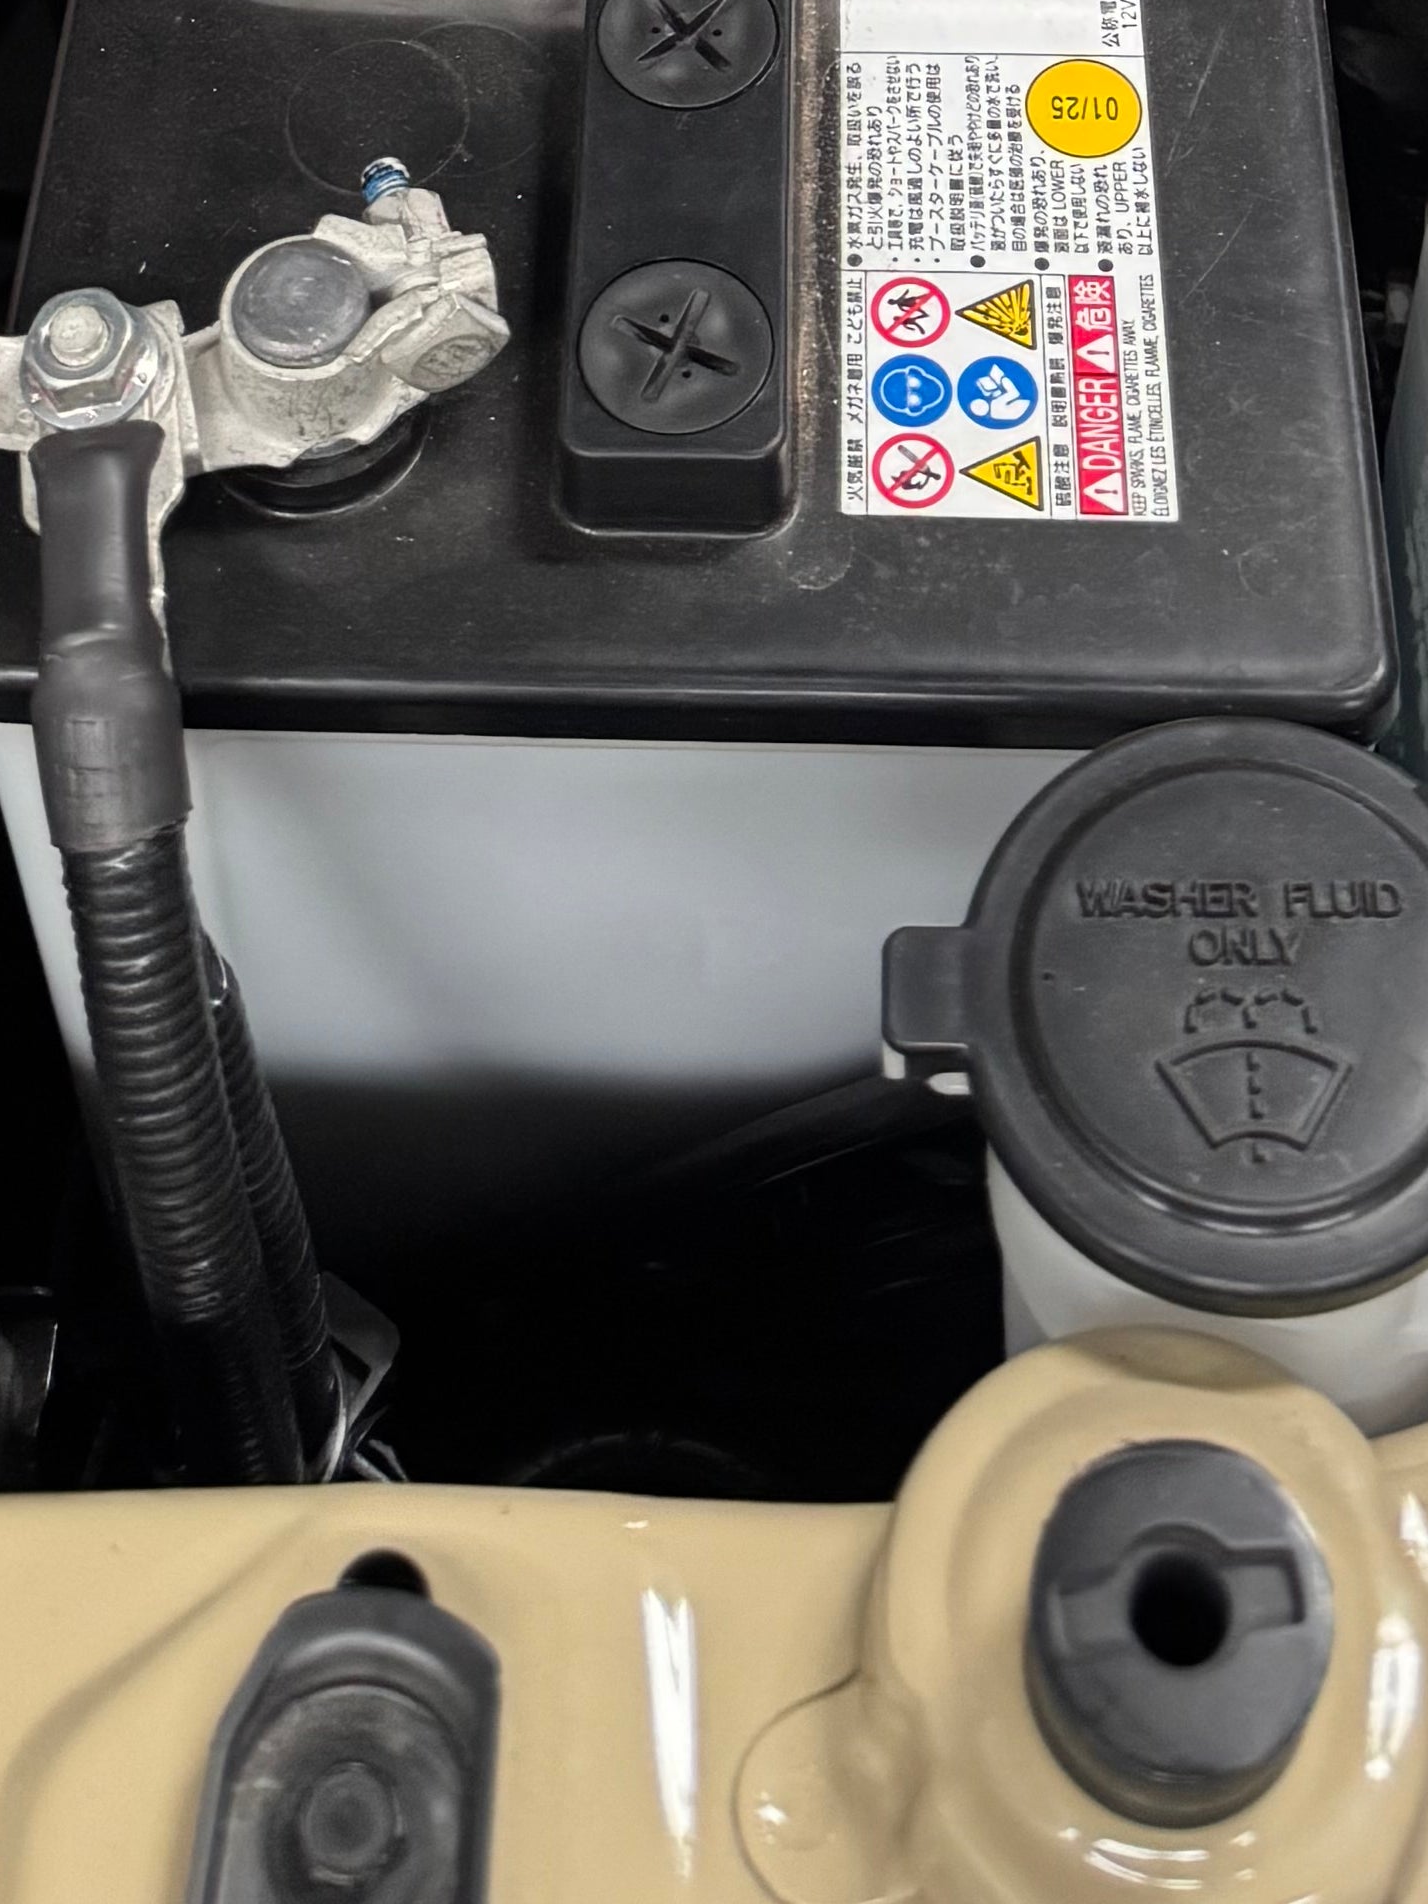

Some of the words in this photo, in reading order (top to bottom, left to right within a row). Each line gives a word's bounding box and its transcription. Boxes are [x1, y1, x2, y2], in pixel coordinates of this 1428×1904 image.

[1120, 0, 1138, 29] 12V
[1050, 96, 1119, 121] 01/25
[925, 64, 945, 250] ブースターケーブルの使用は
[1050, 160, 1066, 210] LOWER
[1112, 161, 1130, 213] UPPER
[1075, 279, 1113, 332] 危険
[1123, 350, 1141, 406] CIGARETTES
[1074, 378, 1122, 471] DANGER
[846, 438, 864, 502] 火気厳禁
[1148, 446, 1166, 465] LES
[1130, 491, 1146, 517] KEEP
[1077, 878, 1257, 920] WASHER
[1283, 878, 1404, 920] FLUID
[1190, 927, 1303, 967] ONLY
